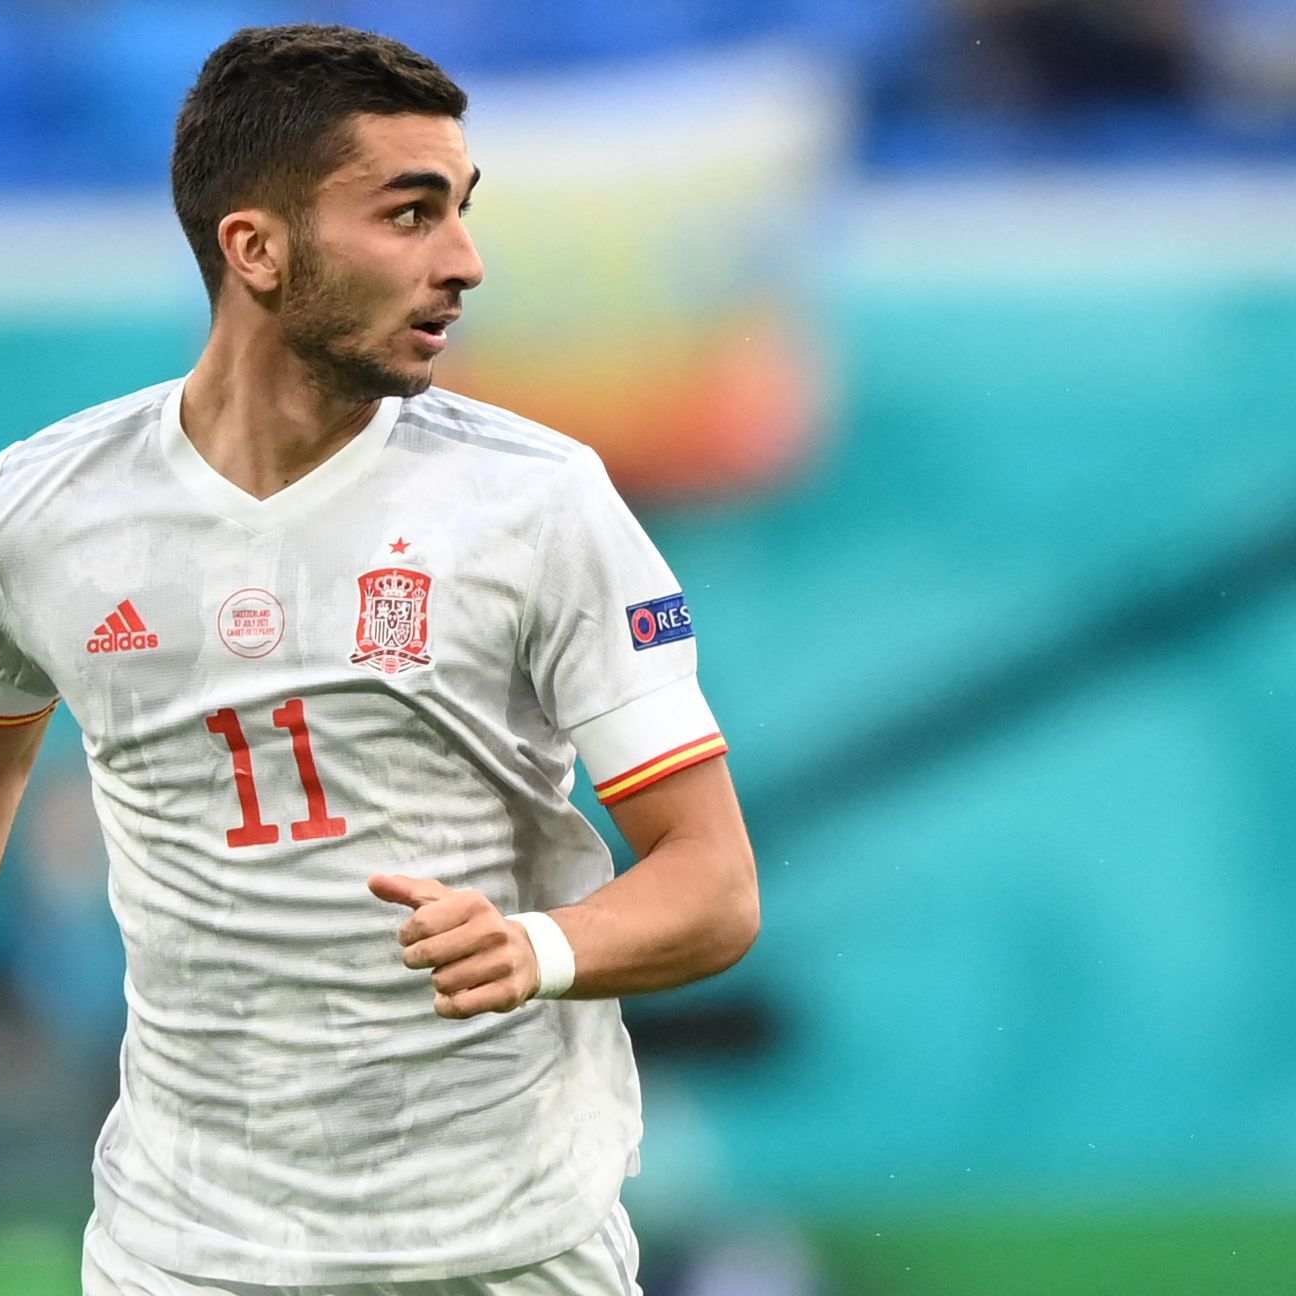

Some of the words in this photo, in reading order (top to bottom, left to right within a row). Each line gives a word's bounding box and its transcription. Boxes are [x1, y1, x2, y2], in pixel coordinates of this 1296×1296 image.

[656, 605, 692, 631] RES
[86, 632, 159, 654] adidas
[206, 698, 347, 848] 11
